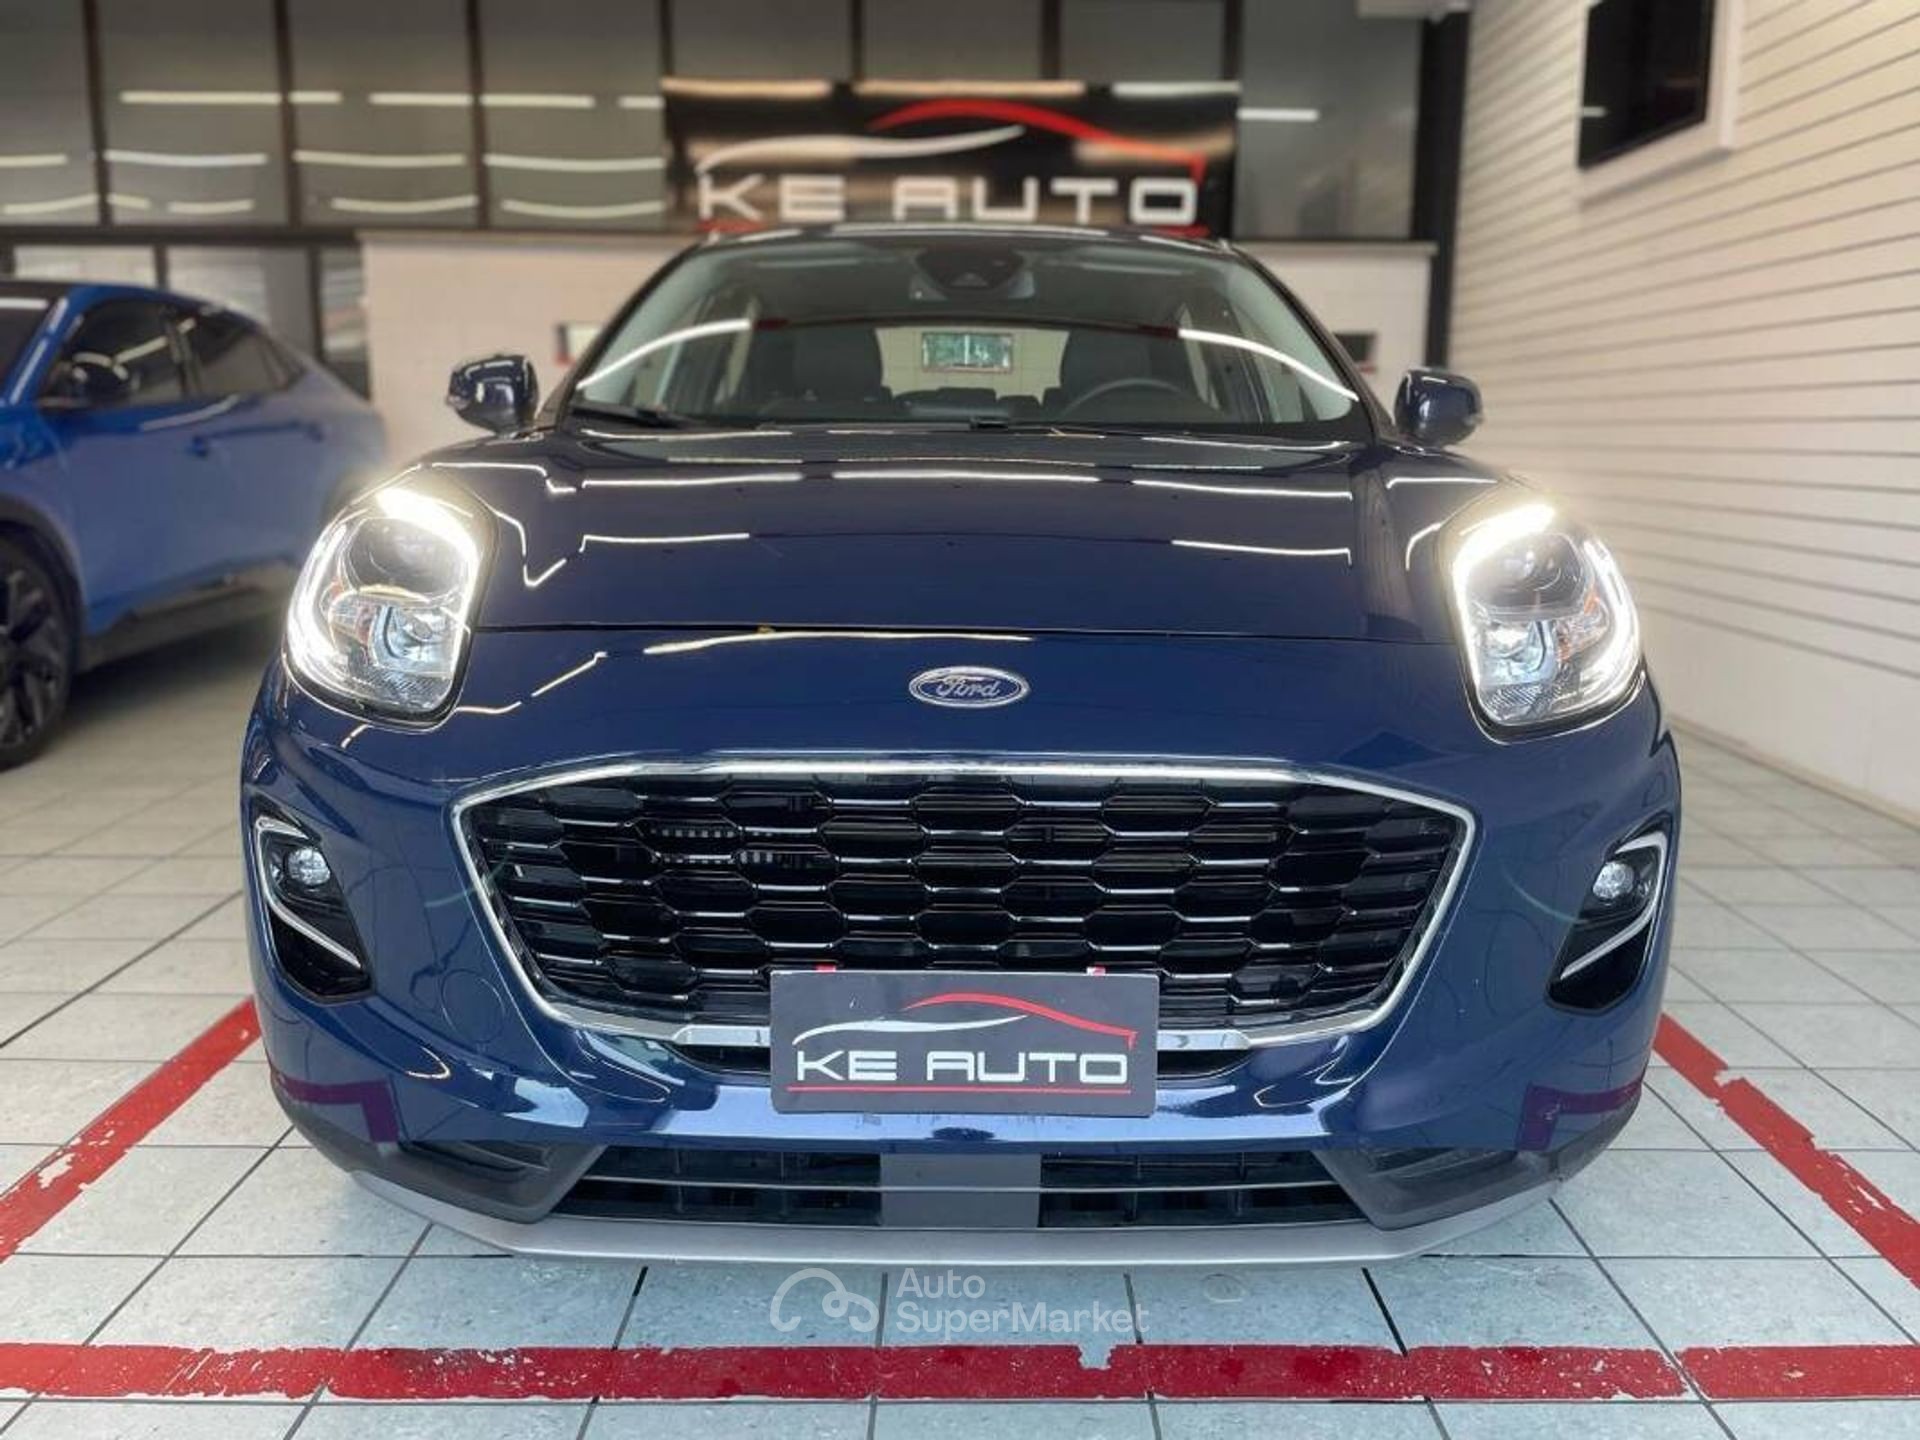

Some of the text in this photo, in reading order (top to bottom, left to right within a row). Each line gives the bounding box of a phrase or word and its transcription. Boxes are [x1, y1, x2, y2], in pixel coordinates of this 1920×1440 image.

[699, 174, 1198, 225] KE AUTO
[935, 677, 1002, 697] Ford
[797, 1050, 1128, 1085] KE AUTO
